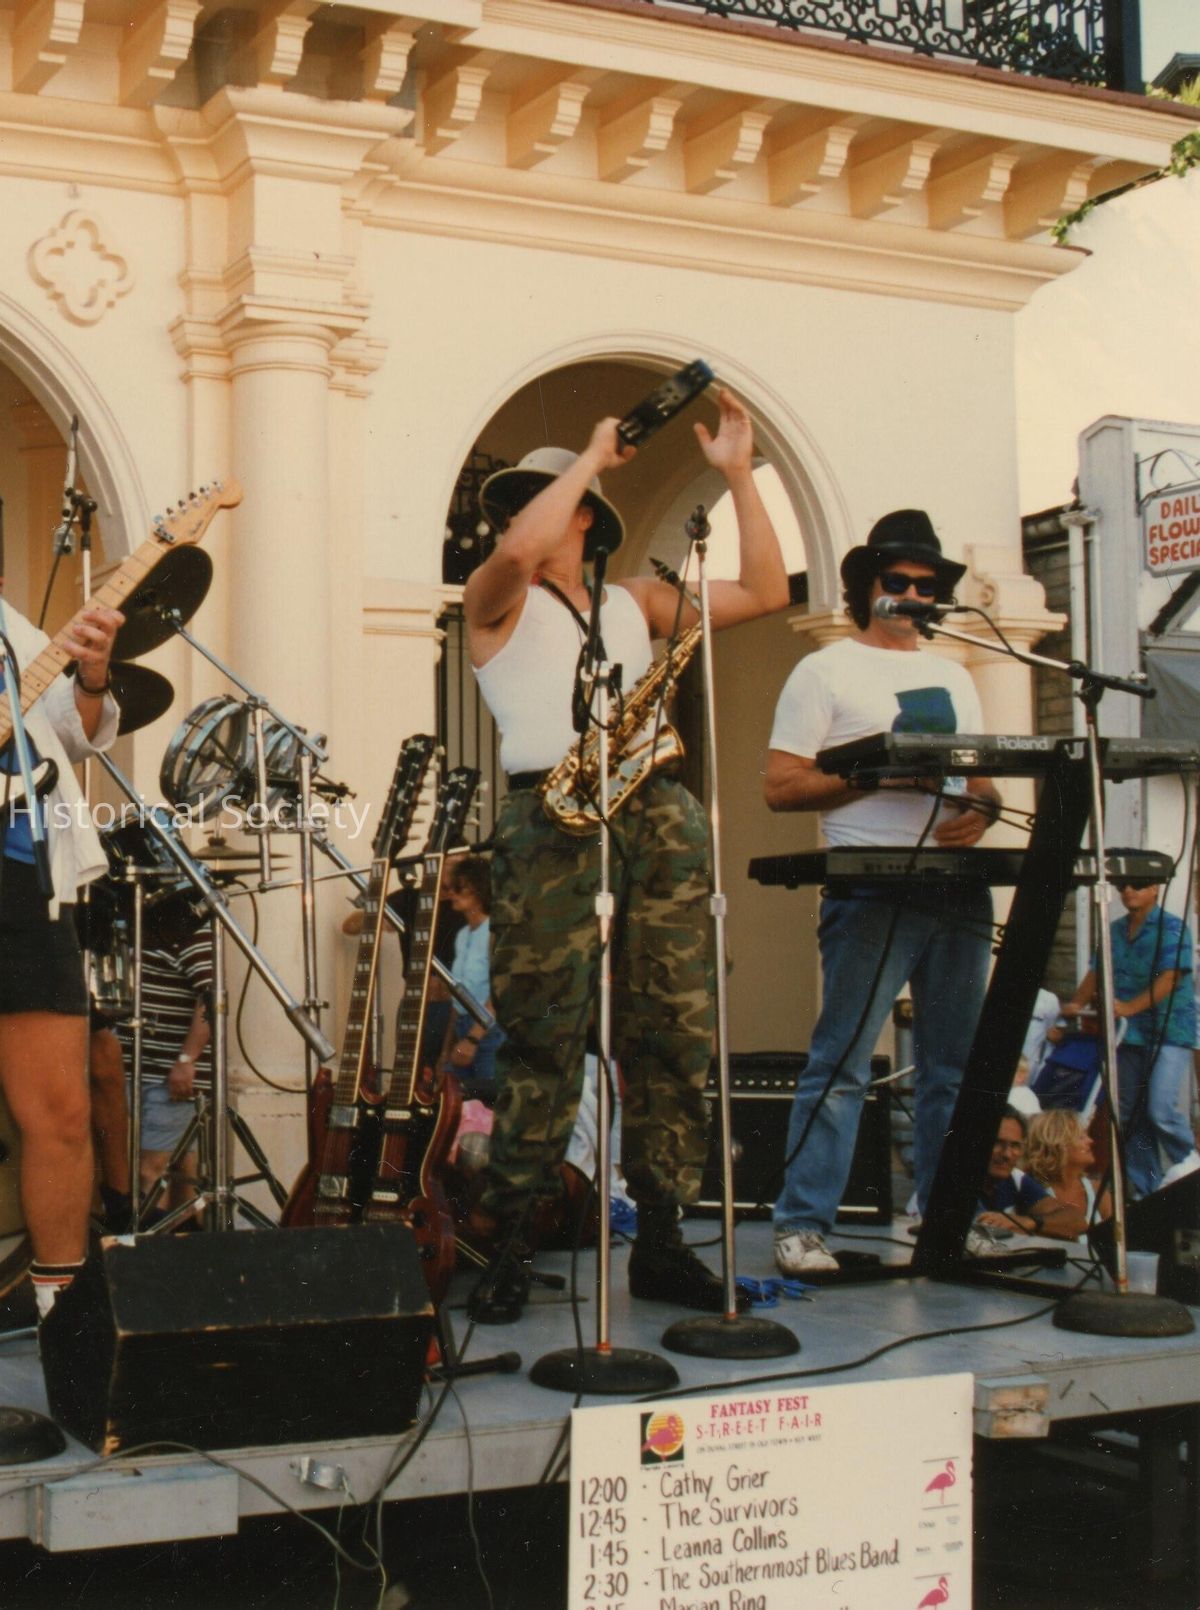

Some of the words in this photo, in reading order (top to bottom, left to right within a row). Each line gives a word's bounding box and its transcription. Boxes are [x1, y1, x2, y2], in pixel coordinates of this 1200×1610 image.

[997, 735, 1050, 751] Roland
[710, 1400, 771, 1418] FANTASY
[777, 1396, 809, 1412] FEST
[580, 1476, 627, 1505] 12:00
[660, 1471, 713, 1502] Cathy
[726, 1465, 770, 1492] Grier
[580, 1508, 627, 1538] 12:45
[659, 1502, 702, 1529] The
[709, 1496, 799, 1525] Survivors
[590, 1540, 628, 1568] 1:45
[661, 1537, 723, 1562] Leanna
[732, 1525, 788, 1553] Collins
[584, 1571, 629, 1600] 2:30
[656, 1566, 690, 1592] The
[699, 1550, 810, 1590] Southernmost
[816, 1547, 856, 1575] Blues
[860, 1538, 899, 1569] Band
